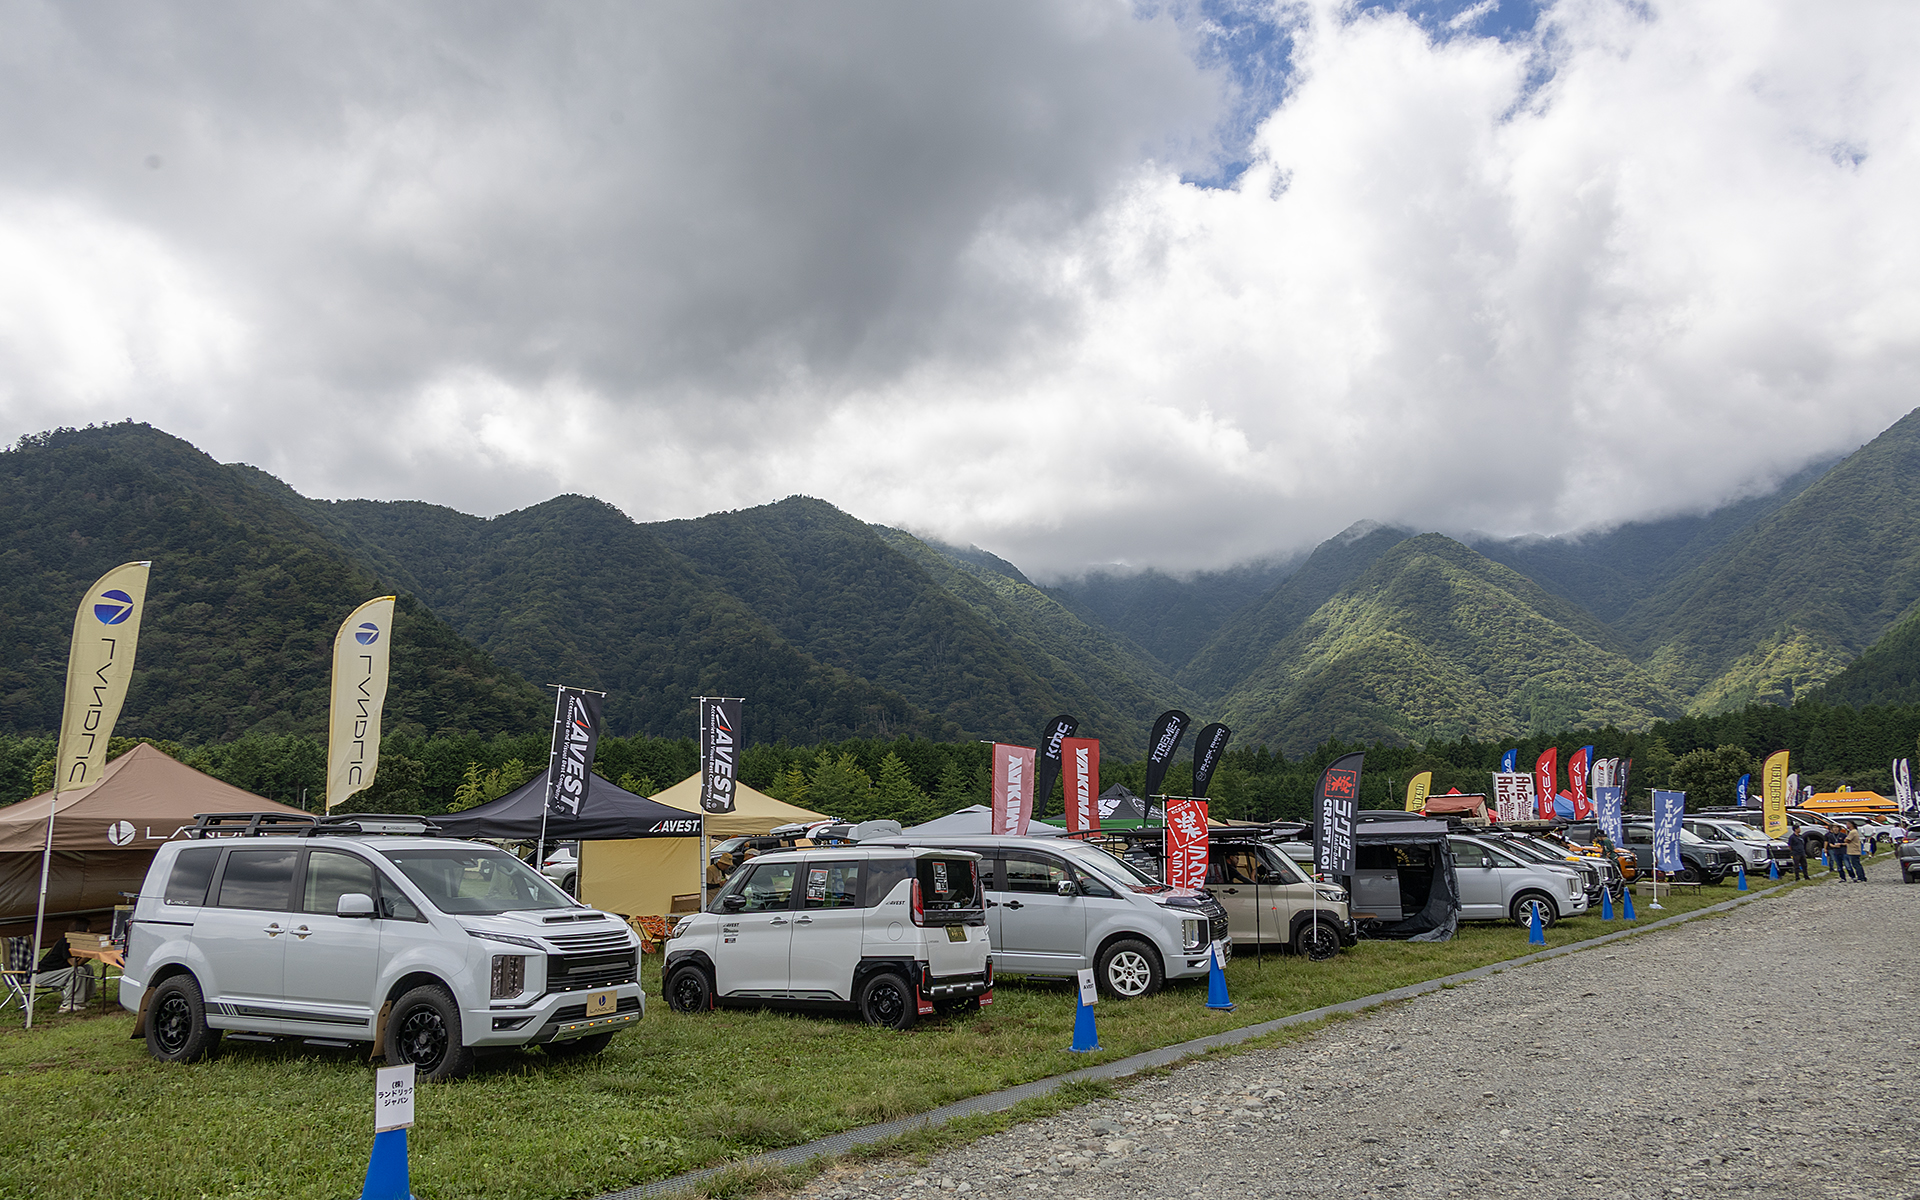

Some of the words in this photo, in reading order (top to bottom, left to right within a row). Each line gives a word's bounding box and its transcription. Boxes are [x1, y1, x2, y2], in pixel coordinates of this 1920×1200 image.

[560, 722, 590, 815] AVEST
[713, 728, 733, 809] AVEST
[1200, 748, 1213, 771] BLACK
[1075, 747, 1090, 830] YAKIMA
[660, 820, 699, 832] AVEST
[1174, 811, 1203, 842] 楽
[1322, 798, 1333, 844] CRAFT
[1320, 846, 1331, 870] AOI
[378, 1087, 413, 1099] ランドリック
[384, 1097, 409, 1107] ジャパン
